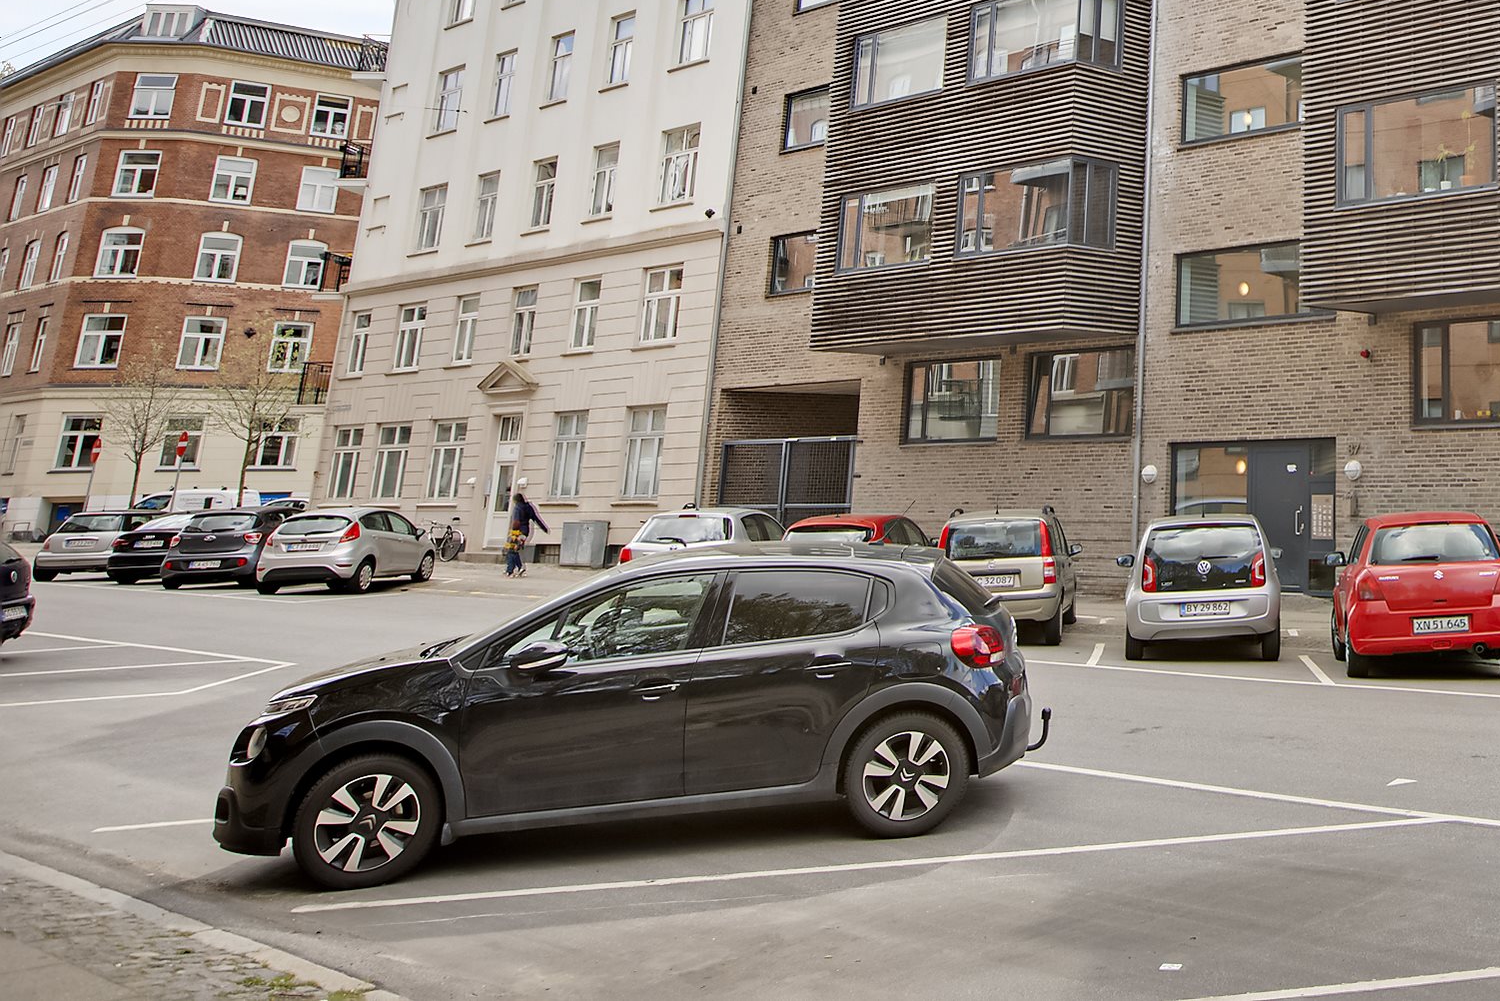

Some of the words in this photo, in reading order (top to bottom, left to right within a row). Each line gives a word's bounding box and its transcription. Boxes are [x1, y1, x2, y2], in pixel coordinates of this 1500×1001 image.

[1186, 603, 1199, 612] BY
[1200, 603, 1211, 612] 29
[1212, 602, 1228, 611] 862
[1415, 620, 1430, 631] XN
[1432, 619, 1444, 630] 51
[1446, 618, 1466, 629] 645
